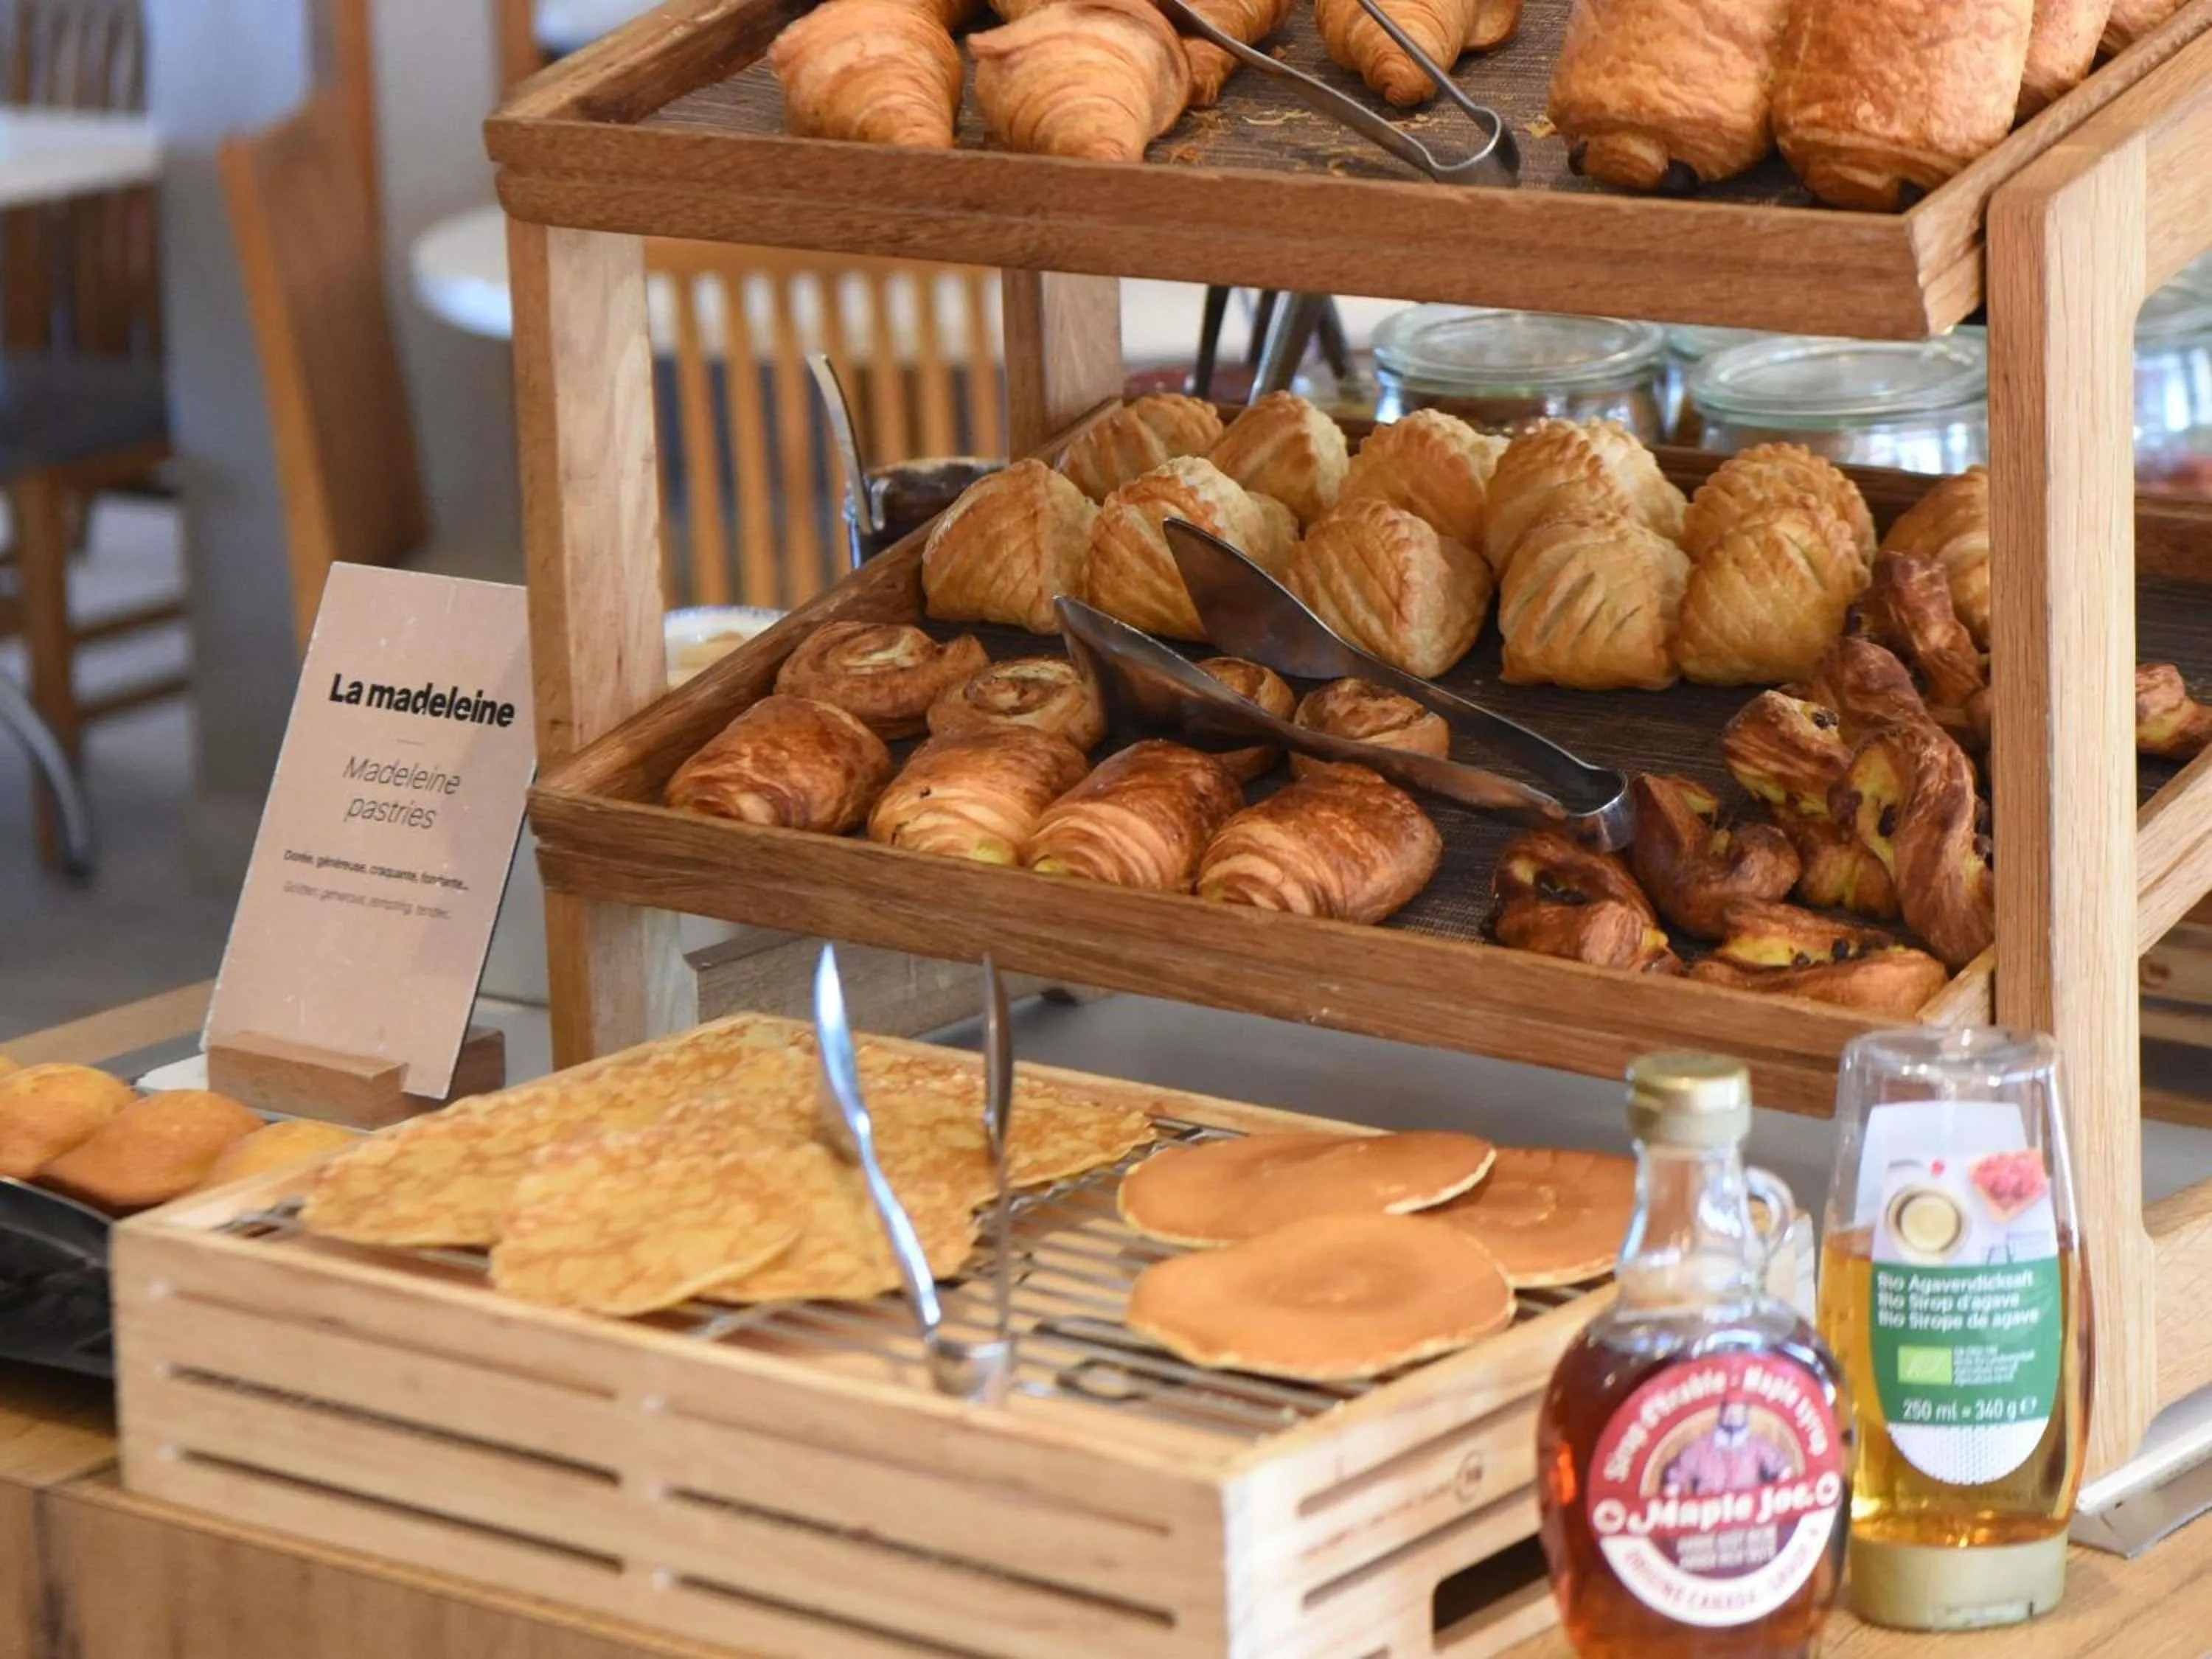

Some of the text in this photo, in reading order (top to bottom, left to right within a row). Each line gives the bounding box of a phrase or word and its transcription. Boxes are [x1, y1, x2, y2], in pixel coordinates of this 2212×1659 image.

[330, 672, 515, 728] La madeleine
[343, 756, 461, 795] Madeleine
[344, 797, 437, 830] pastries
[1877, 1268, 2034, 1294] Bio Agavendicksaft
[1877, 1291, 2020, 1313] Bio Sirop d'agave
[1877, 1307, 2040, 1333] Bio Sirope de agave
[1743, 1364, 1801, 1409] Maple
[1902, 1397, 1933, 1421] 250
[1935, 1399, 1958, 1421] ml
[1975, 1397, 2004, 1421] 340
[2006, 1399, 2018, 1422] g
[1627, 1488, 1753, 1532] Maple
